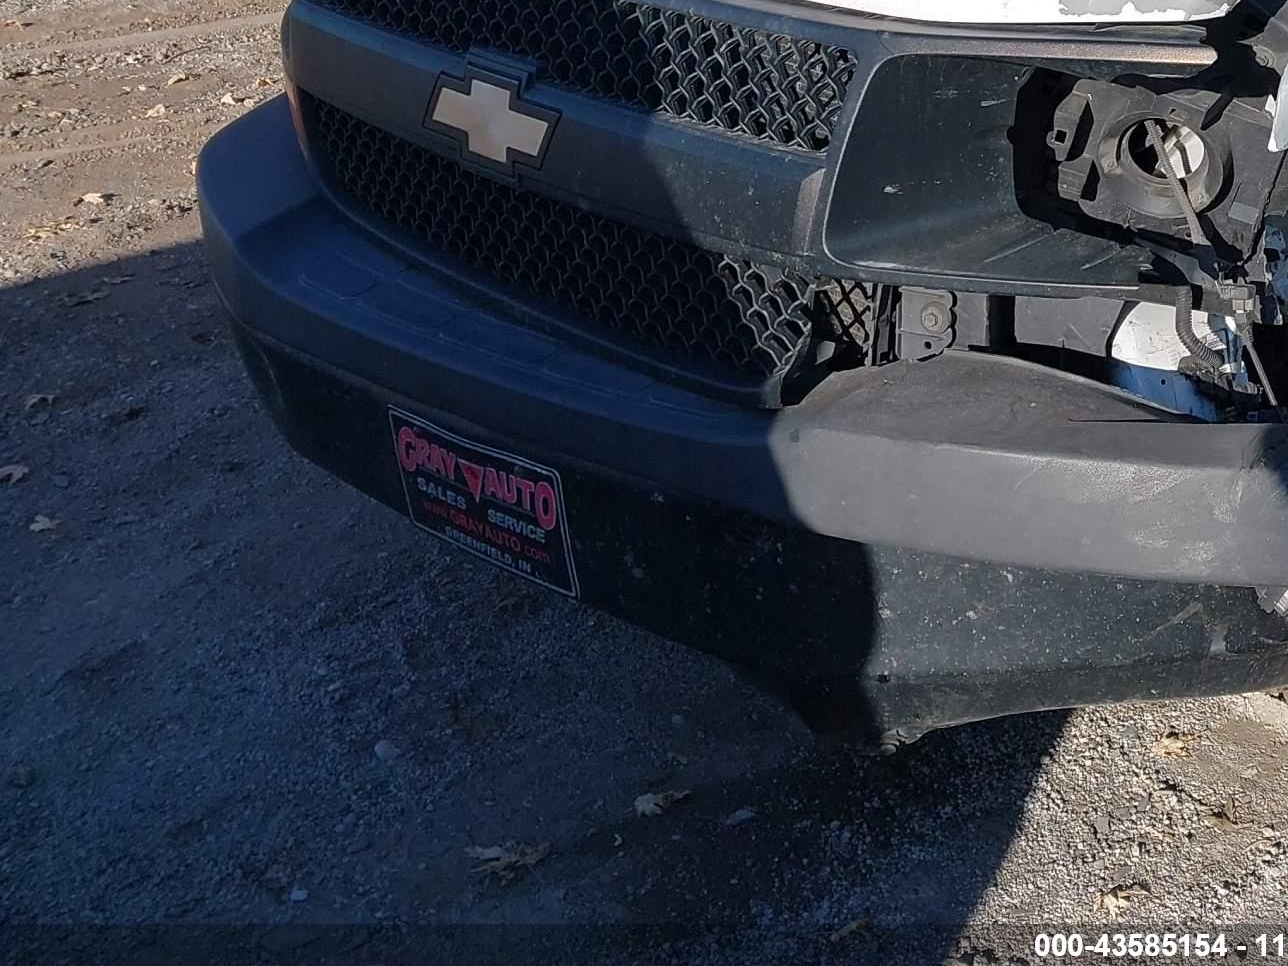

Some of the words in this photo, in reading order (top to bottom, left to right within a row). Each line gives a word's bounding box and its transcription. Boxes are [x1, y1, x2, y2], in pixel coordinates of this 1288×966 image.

[398, 426, 456, 480] GRAY
[484, 466, 557, 530] AUTO
[416, 476, 466, 510] SALES
[488, 509, 545, 543] SERVICE
[518, 560, 531, 573] IN
